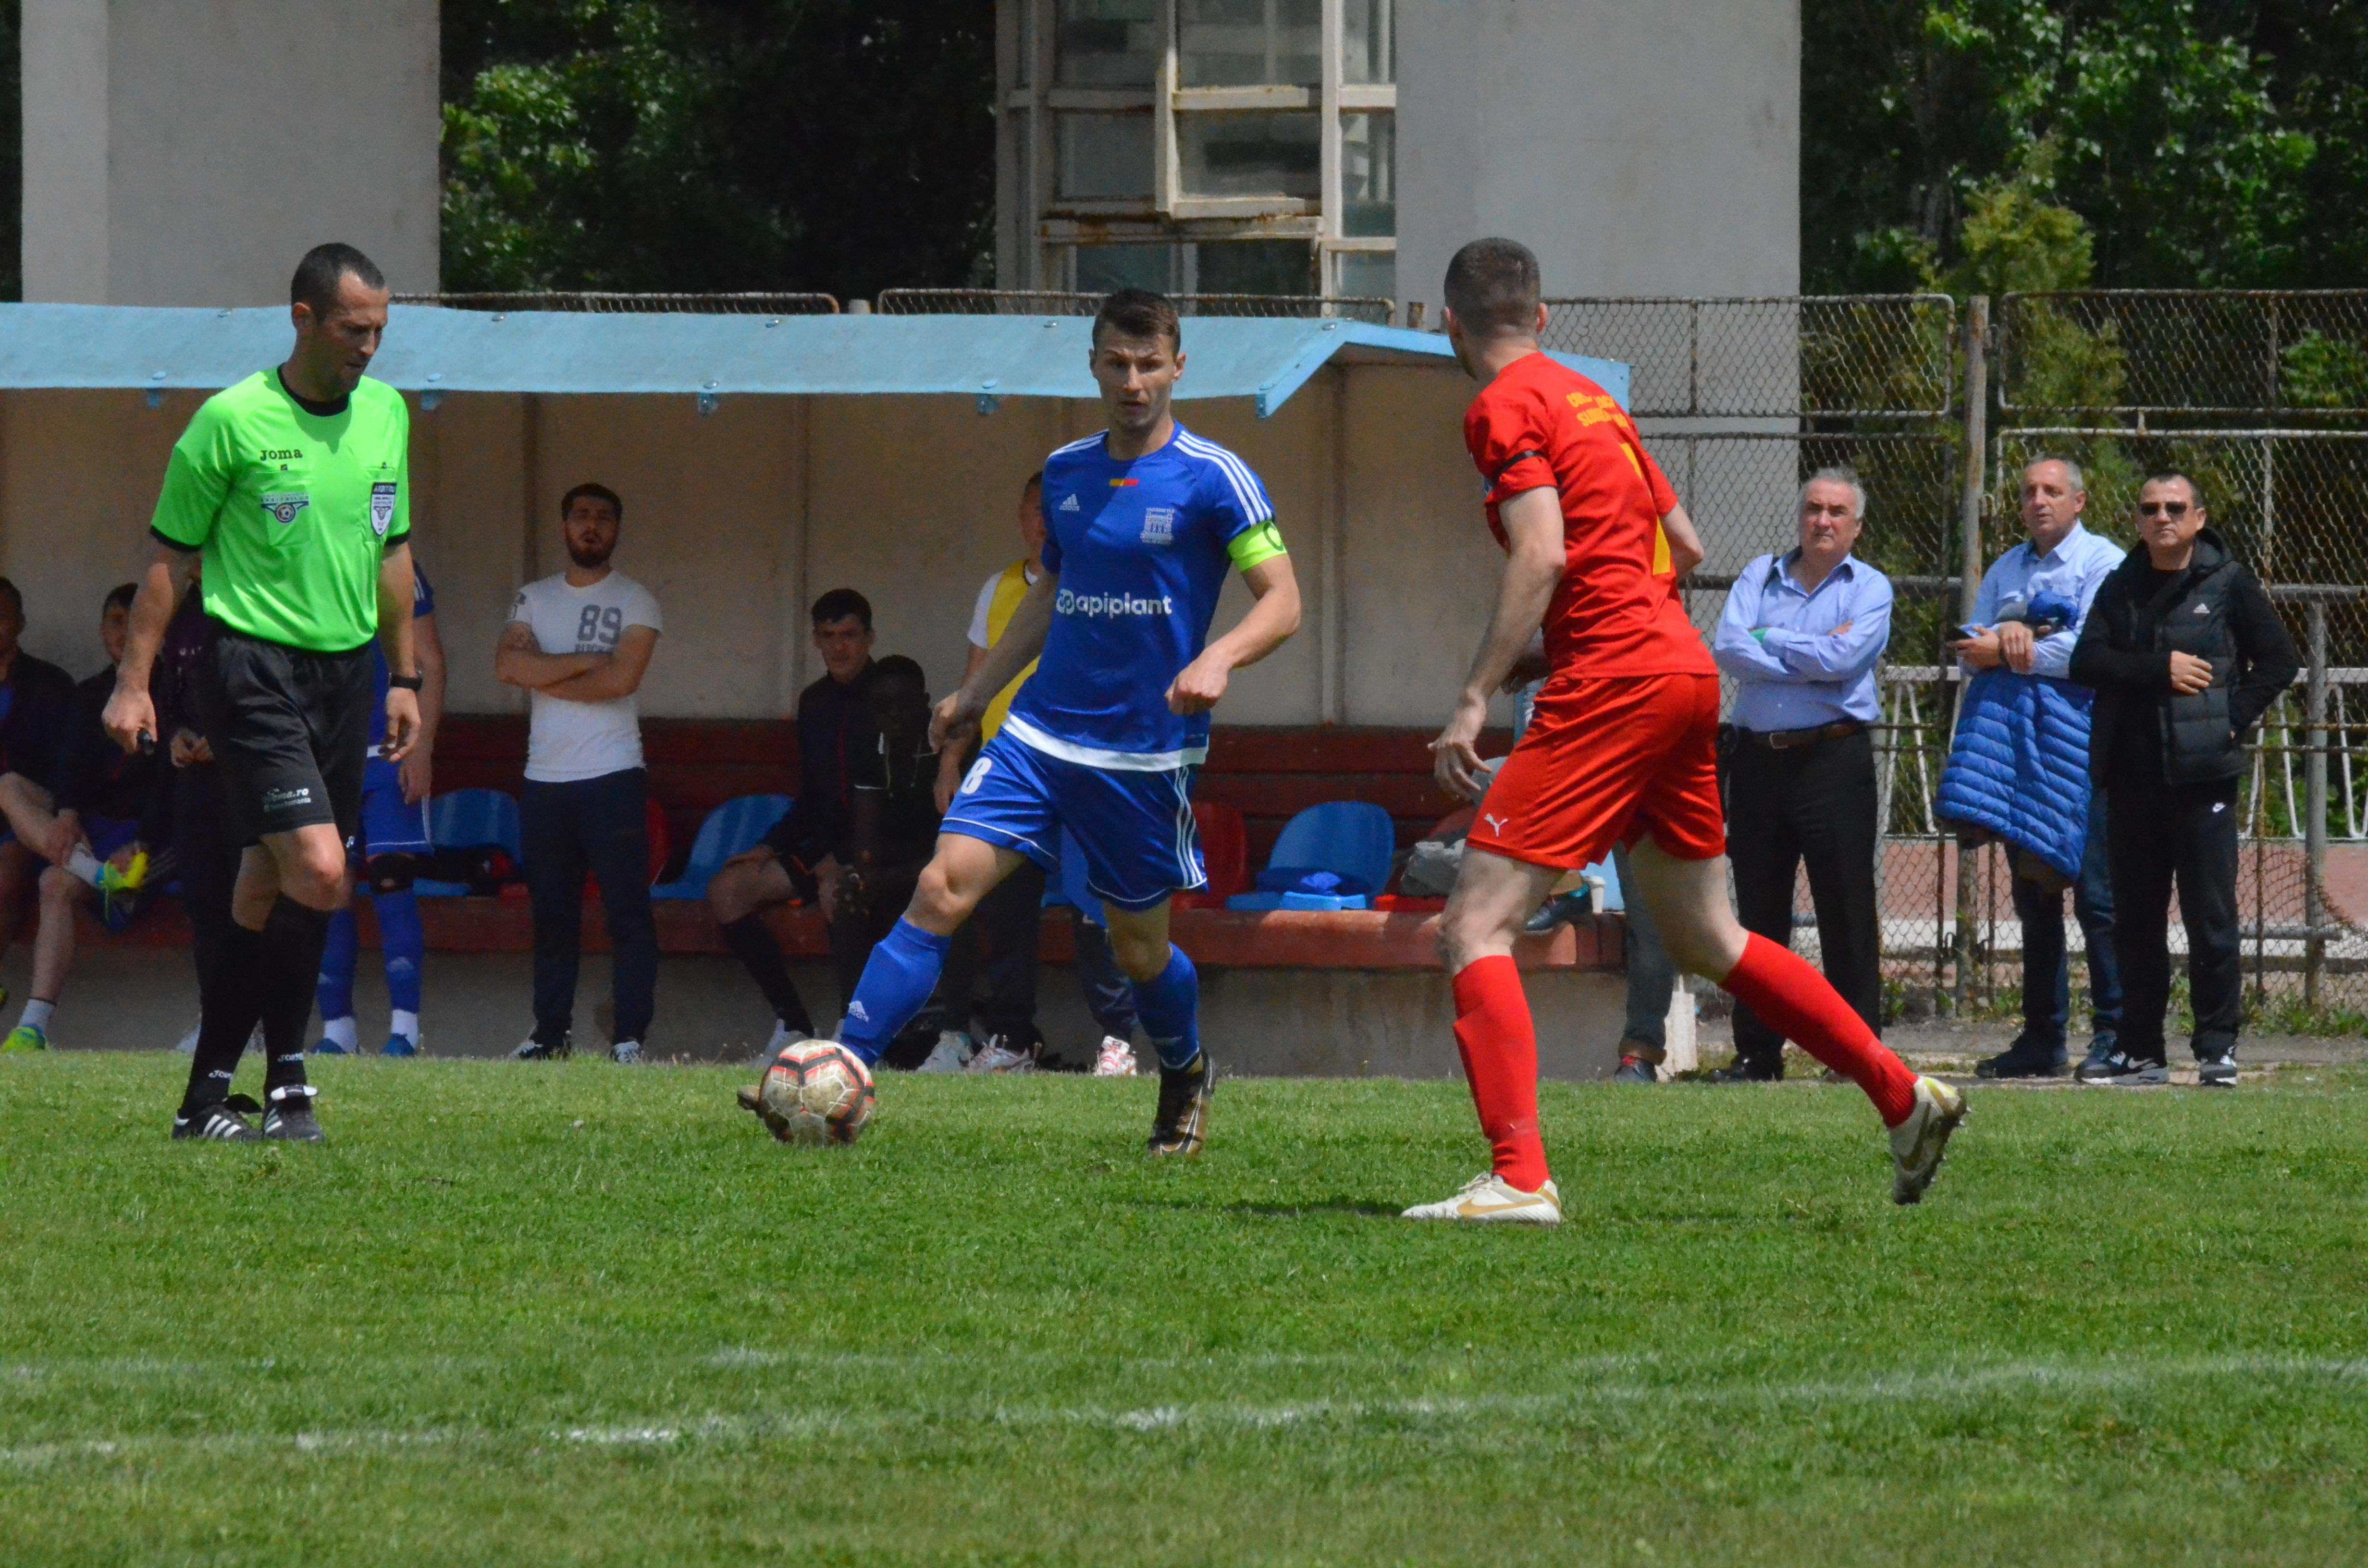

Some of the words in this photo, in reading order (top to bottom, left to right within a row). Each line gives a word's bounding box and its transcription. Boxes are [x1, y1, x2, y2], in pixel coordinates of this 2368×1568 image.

[1076, 591, 1172, 619] apiplant
[578, 604, 621, 645] 89
[961, 757, 992, 794] 8
